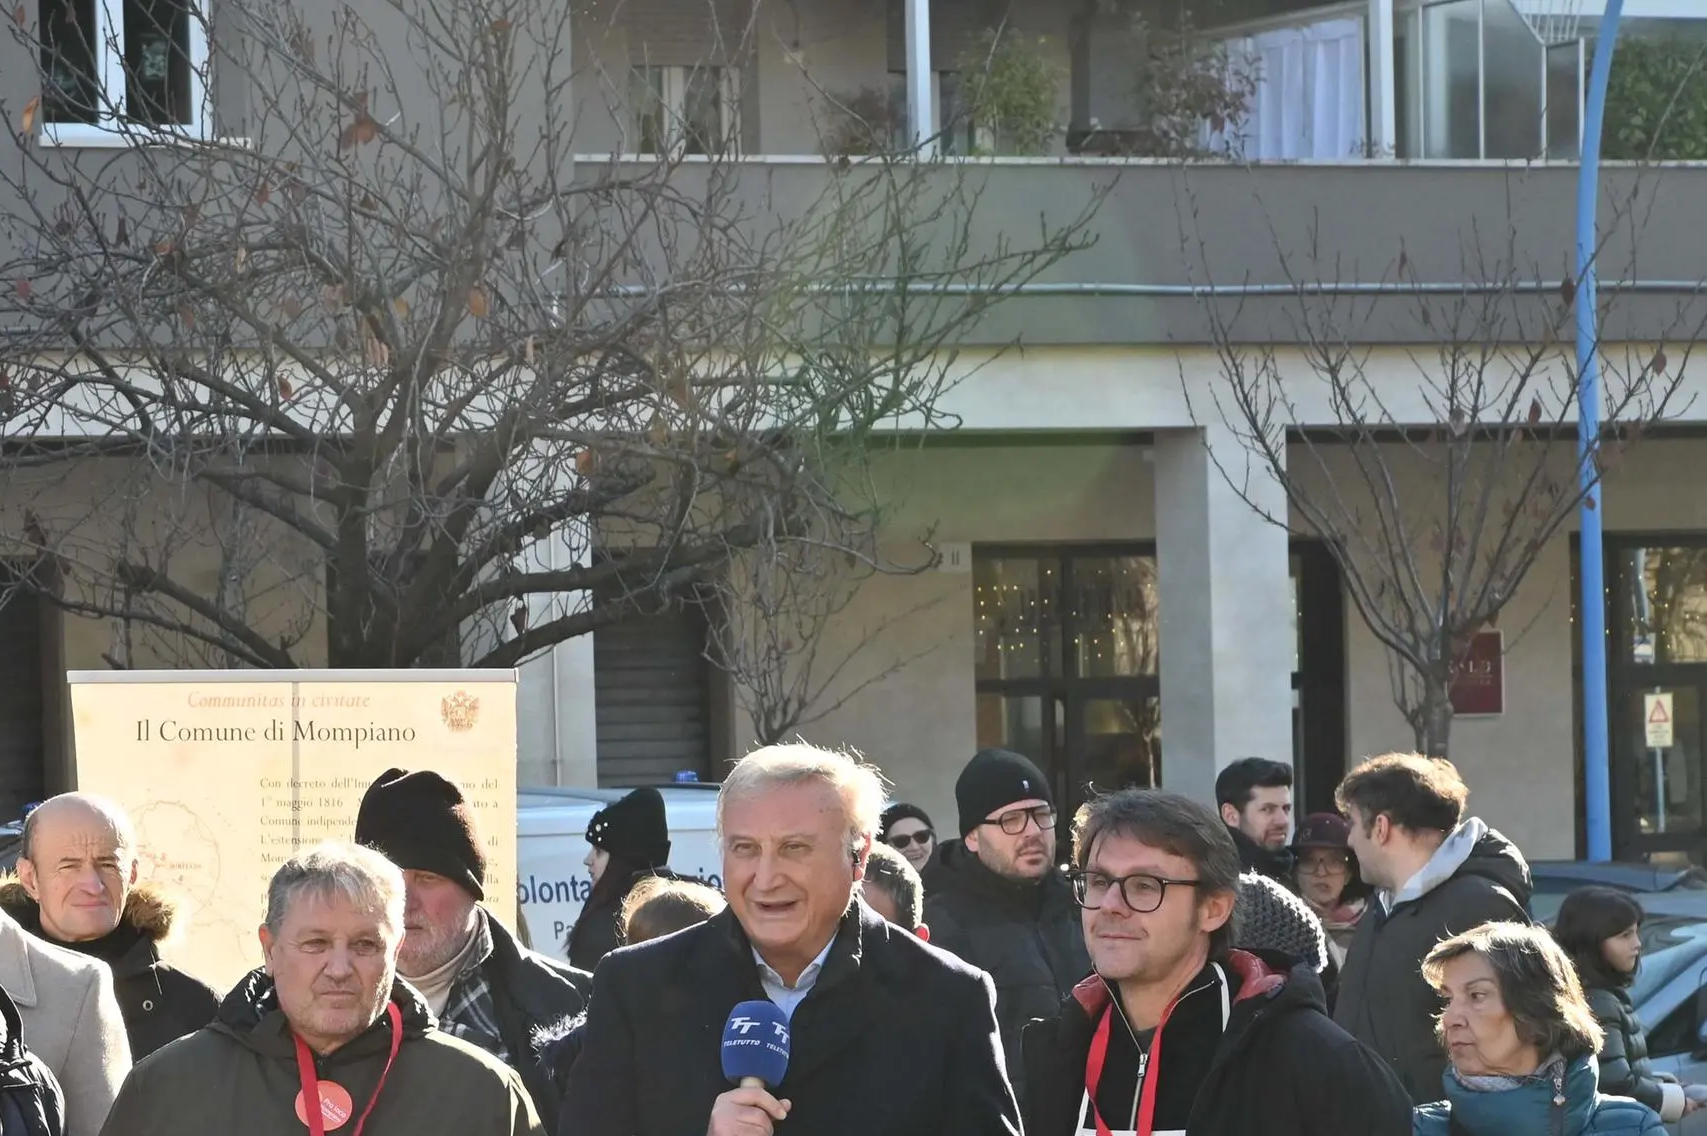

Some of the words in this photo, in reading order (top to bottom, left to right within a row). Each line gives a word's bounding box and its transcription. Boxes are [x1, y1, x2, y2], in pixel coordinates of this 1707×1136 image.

[187, 691, 285, 708] Communitas
[291, 692, 305, 708] in
[312, 693, 371, 708] civitate
[136, 719, 150, 741] Il
[159, 719, 257, 742] Comune
[263, 719, 284, 742] di
[292, 719, 417, 750] Mompiano
[518, 874, 591, 905] olonta
